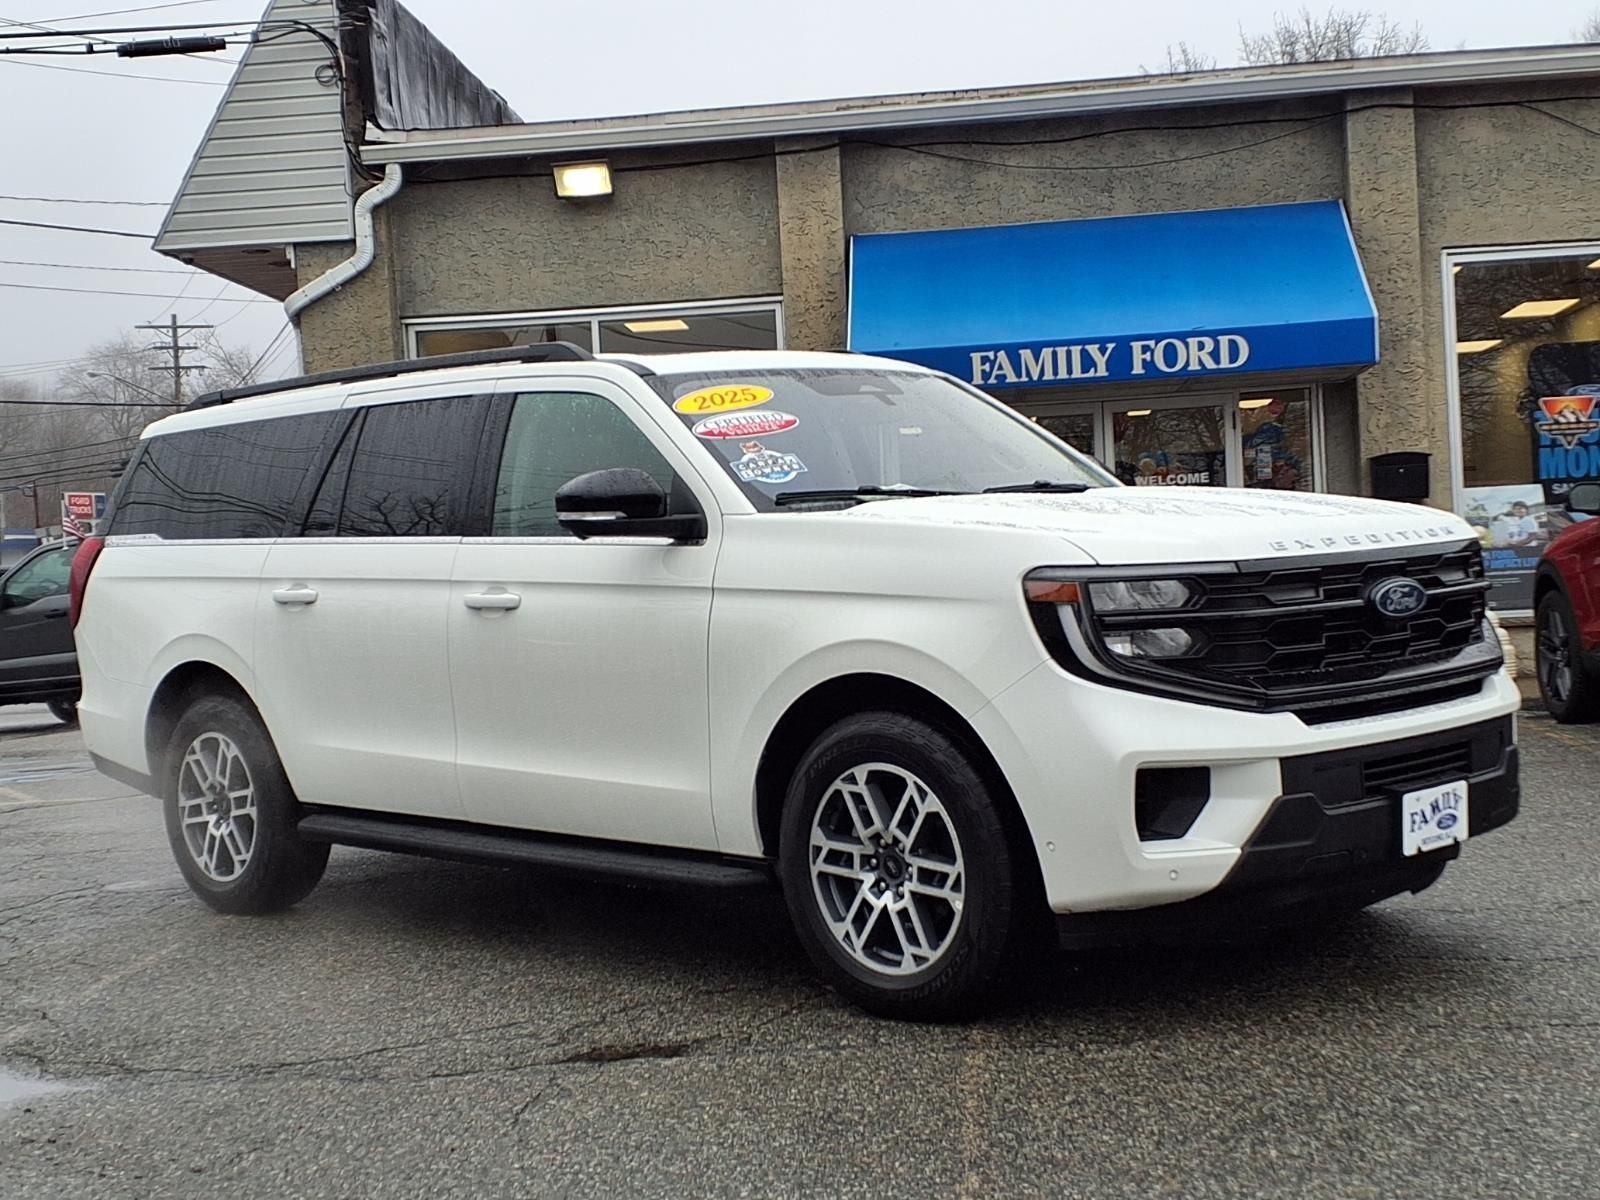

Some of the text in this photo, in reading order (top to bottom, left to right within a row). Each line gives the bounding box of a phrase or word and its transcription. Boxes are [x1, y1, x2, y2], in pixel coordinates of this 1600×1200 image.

[969, 335, 1249, 385] FAMILY FORD
[694, 388, 757, 411] 2025
[703, 412, 784, 429] CERTIFIED
[1134, 472, 1210, 486] WELCOME
[1268, 526, 1456, 551] EXPEDITION
[1386, 586, 1419, 612] Ford
[1409, 790, 1463, 833] FAMILY
